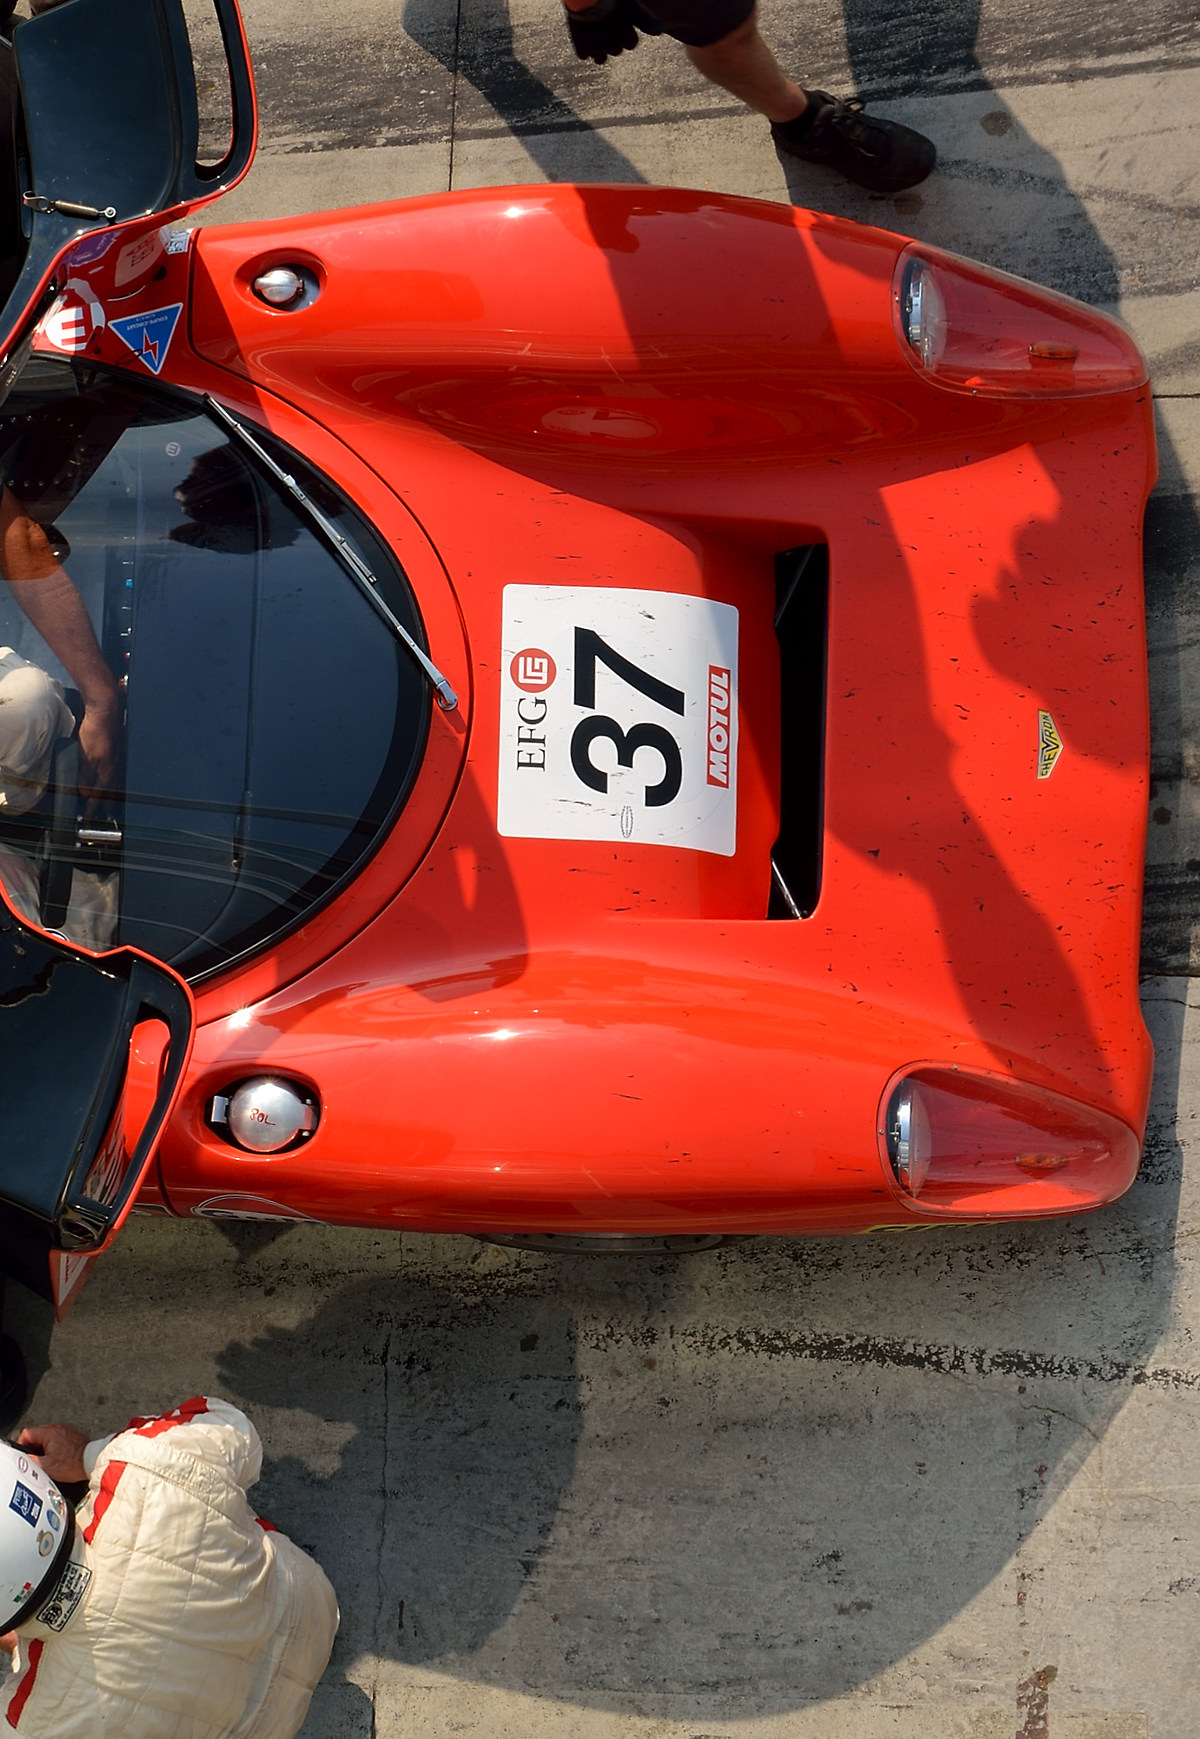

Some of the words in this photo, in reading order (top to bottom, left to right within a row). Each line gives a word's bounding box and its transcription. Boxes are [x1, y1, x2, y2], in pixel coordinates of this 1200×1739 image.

[517, 696, 547, 771] EFG
[570, 626, 685, 807] 37
[709, 672, 729, 784] MOTUL
[1041, 714, 1060, 776] CHEVRON
